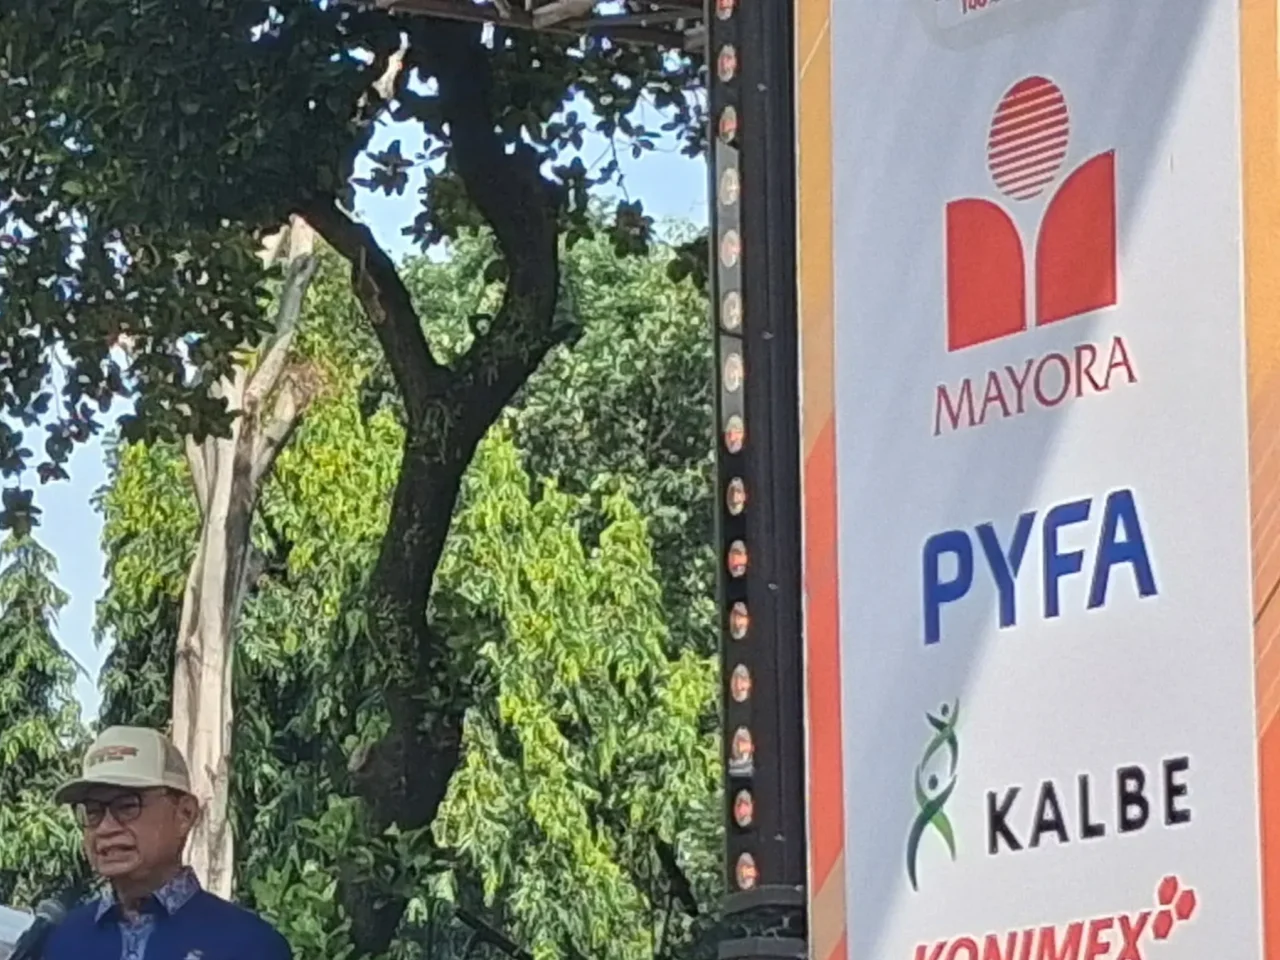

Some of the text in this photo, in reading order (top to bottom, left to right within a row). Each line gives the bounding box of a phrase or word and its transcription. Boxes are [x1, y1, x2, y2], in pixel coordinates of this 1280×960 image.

[933, 336, 1137, 436] MAYORA
[923, 488, 1158, 645] PYFA
[986, 756, 1191, 855] KALBE
